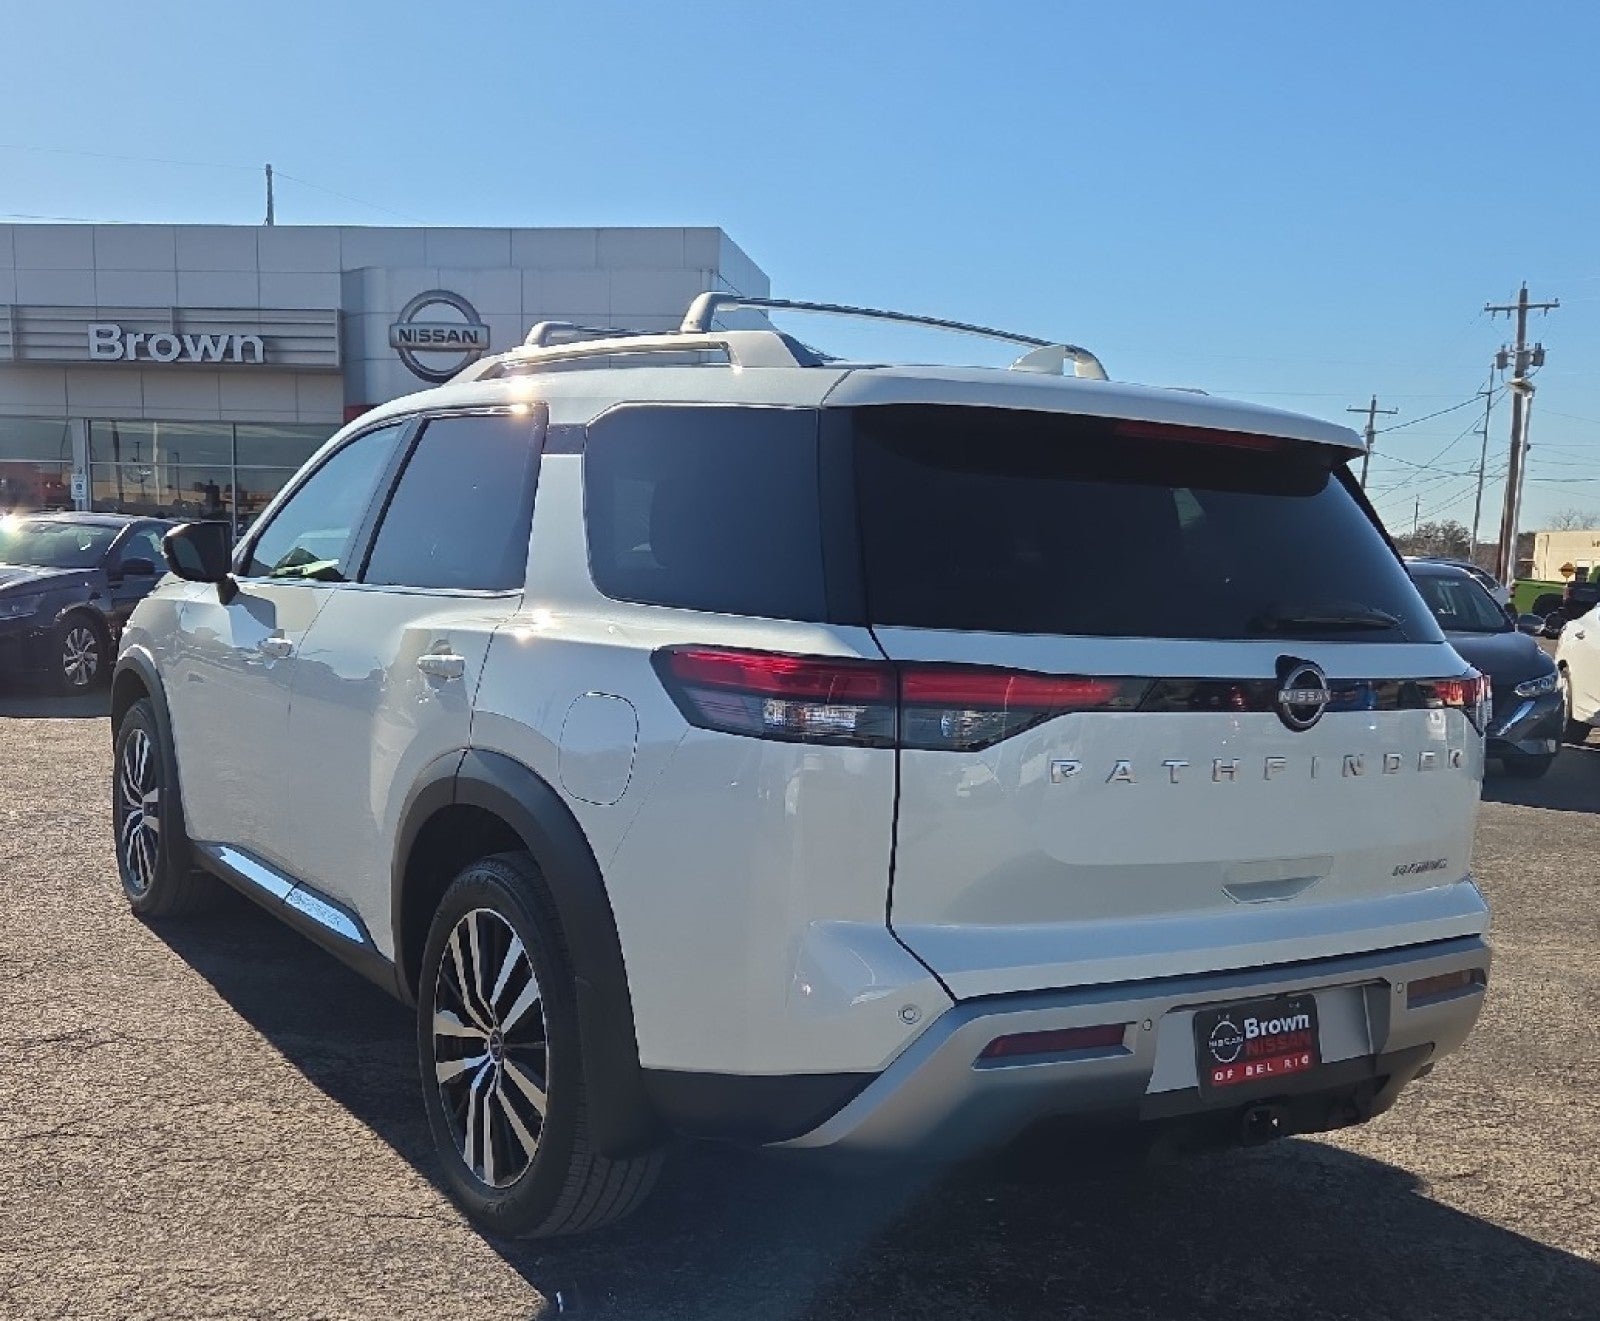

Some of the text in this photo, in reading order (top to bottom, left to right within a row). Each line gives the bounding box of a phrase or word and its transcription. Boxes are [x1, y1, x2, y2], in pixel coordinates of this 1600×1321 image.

[88, 323, 264, 364] Brown
[398, 328, 480, 344] NISSAN
[1279, 691, 1331, 703] NISSAN
[1244, 1014, 1309, 1038] Brown
[1247, 1032, 1312, 1055] NISSAN
[1214, 1054, 1309, 1081] OF DEL RIO
